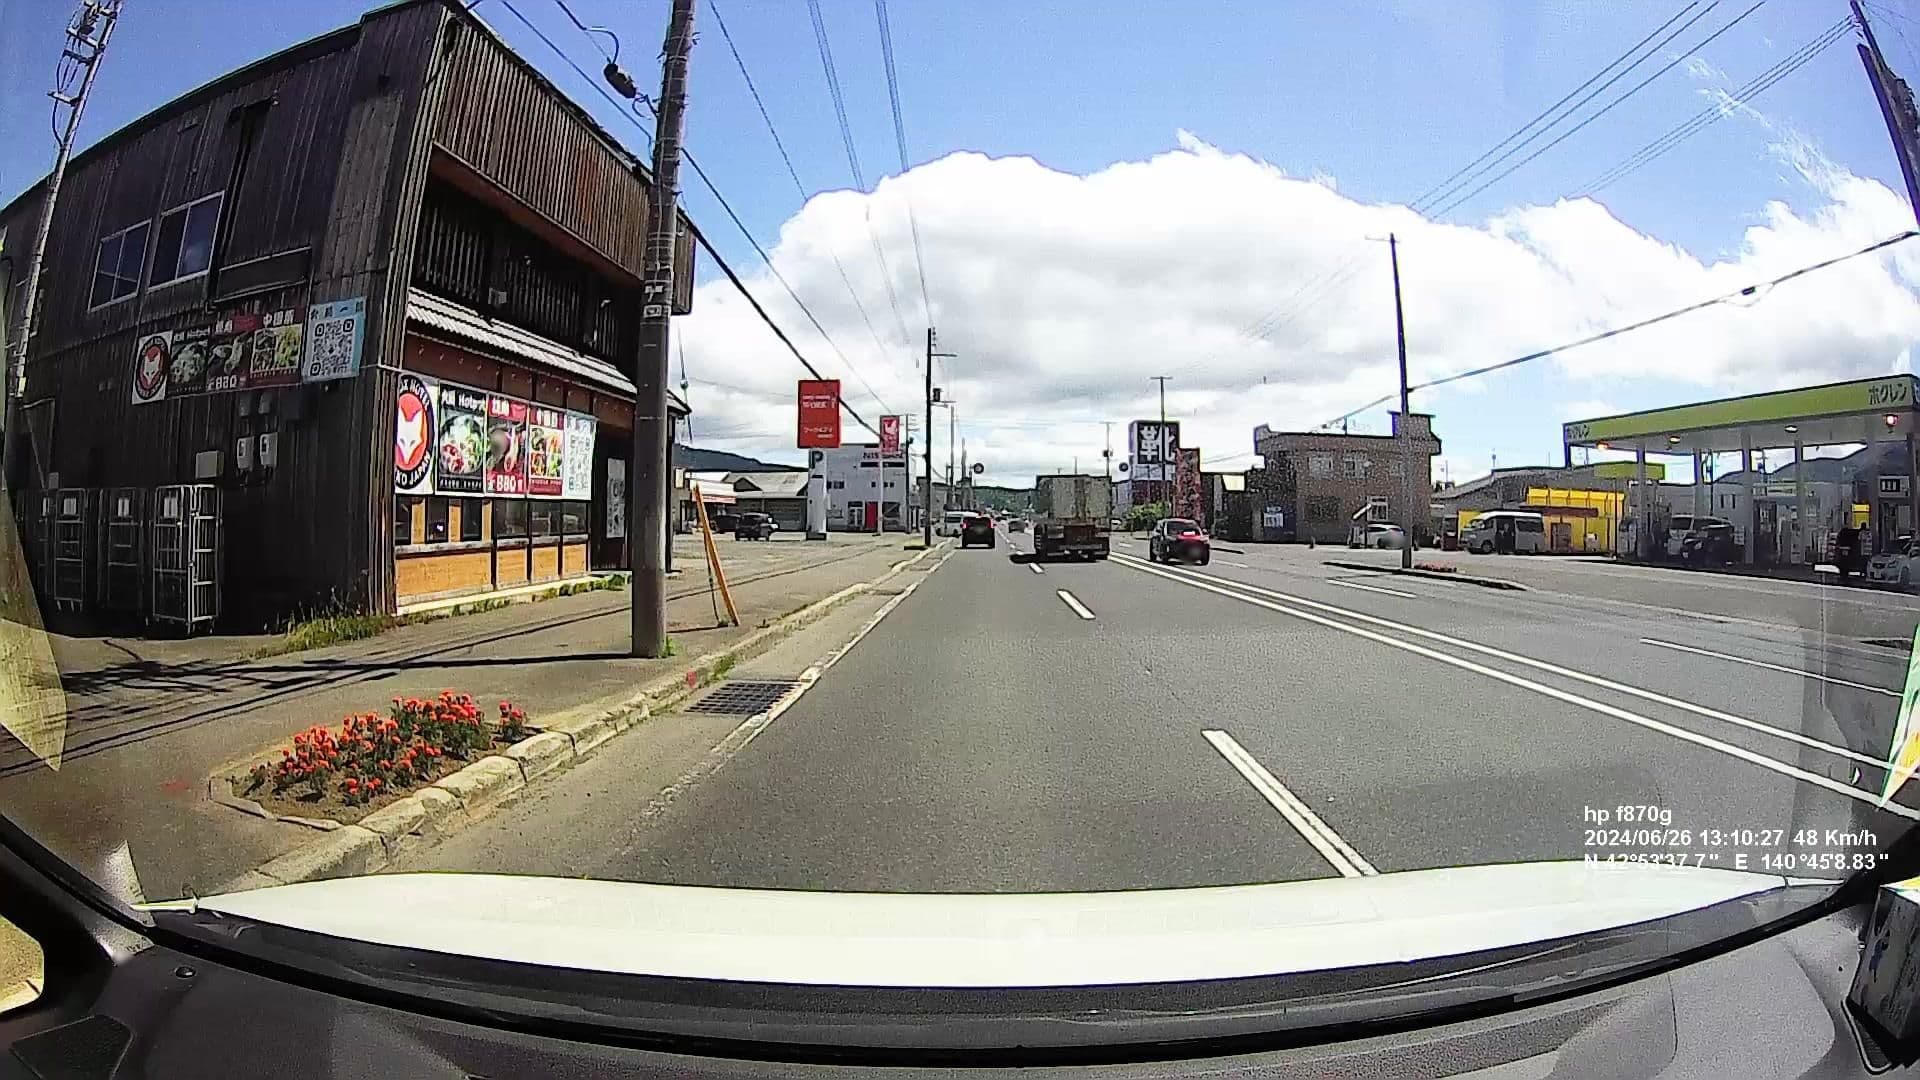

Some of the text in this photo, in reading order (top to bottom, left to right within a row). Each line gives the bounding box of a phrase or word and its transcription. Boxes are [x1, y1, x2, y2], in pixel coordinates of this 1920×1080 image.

[1869, 383, 1907, 405] ホクレン
[1139, 425, 1176, 462] 靴
[409, 450, 431, 485] JAPAN
[811, 450, 824, 469] P
[496, 474, 517, 492] BBQ
